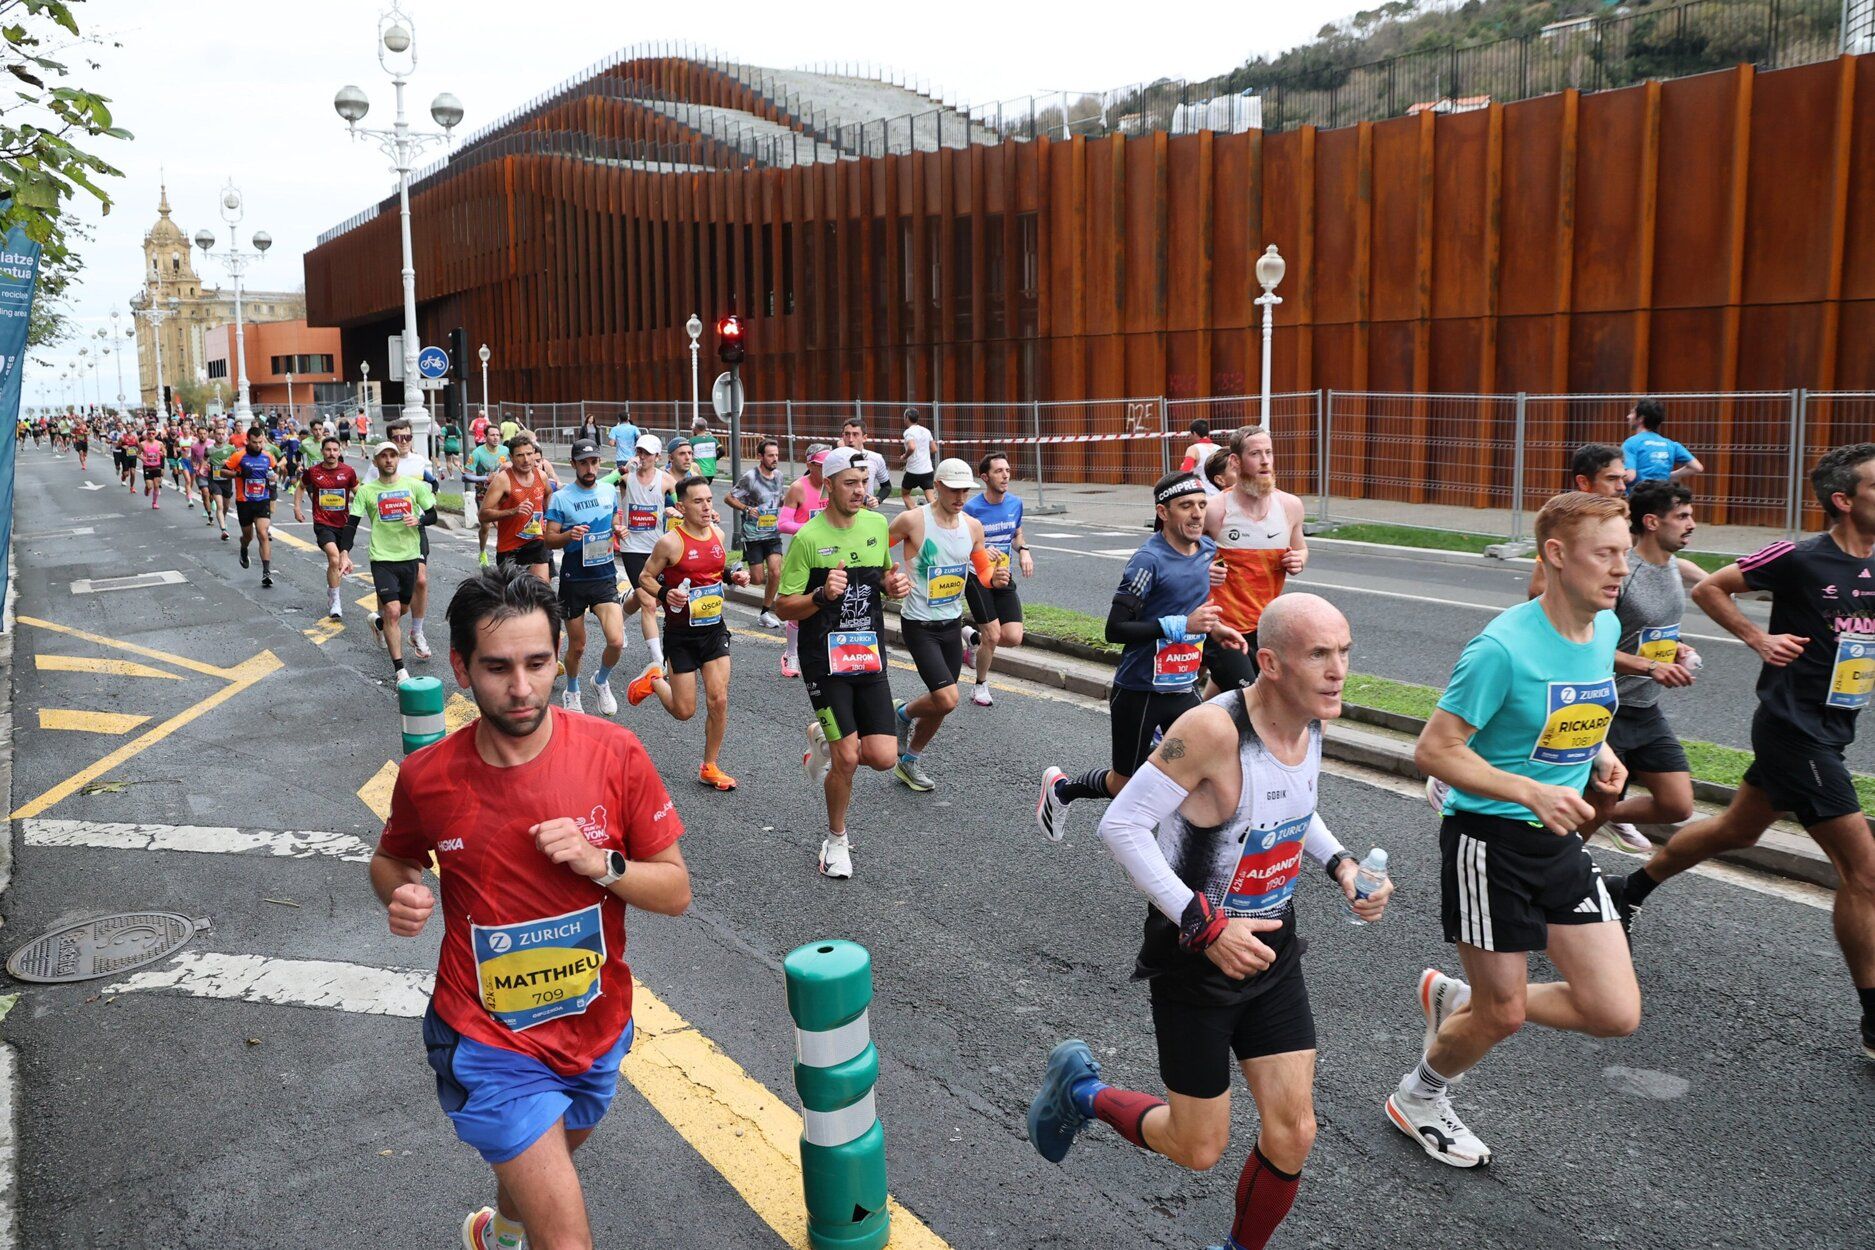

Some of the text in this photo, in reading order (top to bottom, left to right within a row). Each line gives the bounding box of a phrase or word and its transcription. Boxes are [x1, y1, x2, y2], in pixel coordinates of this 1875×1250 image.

[939, 580, 961, 589] MARIO
[842, 653, 873, 662] AARON
[1166, 651, 1200, 662] ANDONI
[1580, 687, 1610, 700] ZURICH
[1559, 716, 1610, 733] RICKARD
[1266, 790, 1287, 800] GOBIK
[437, 837, 465, 852] HOKA
[519, 921, 582, 946] ZURICH
[494, 953, 600, 990] MATTHIEU
[486, 991, 497, 1010] 42k
[532, 988, 564, 1005] 709
